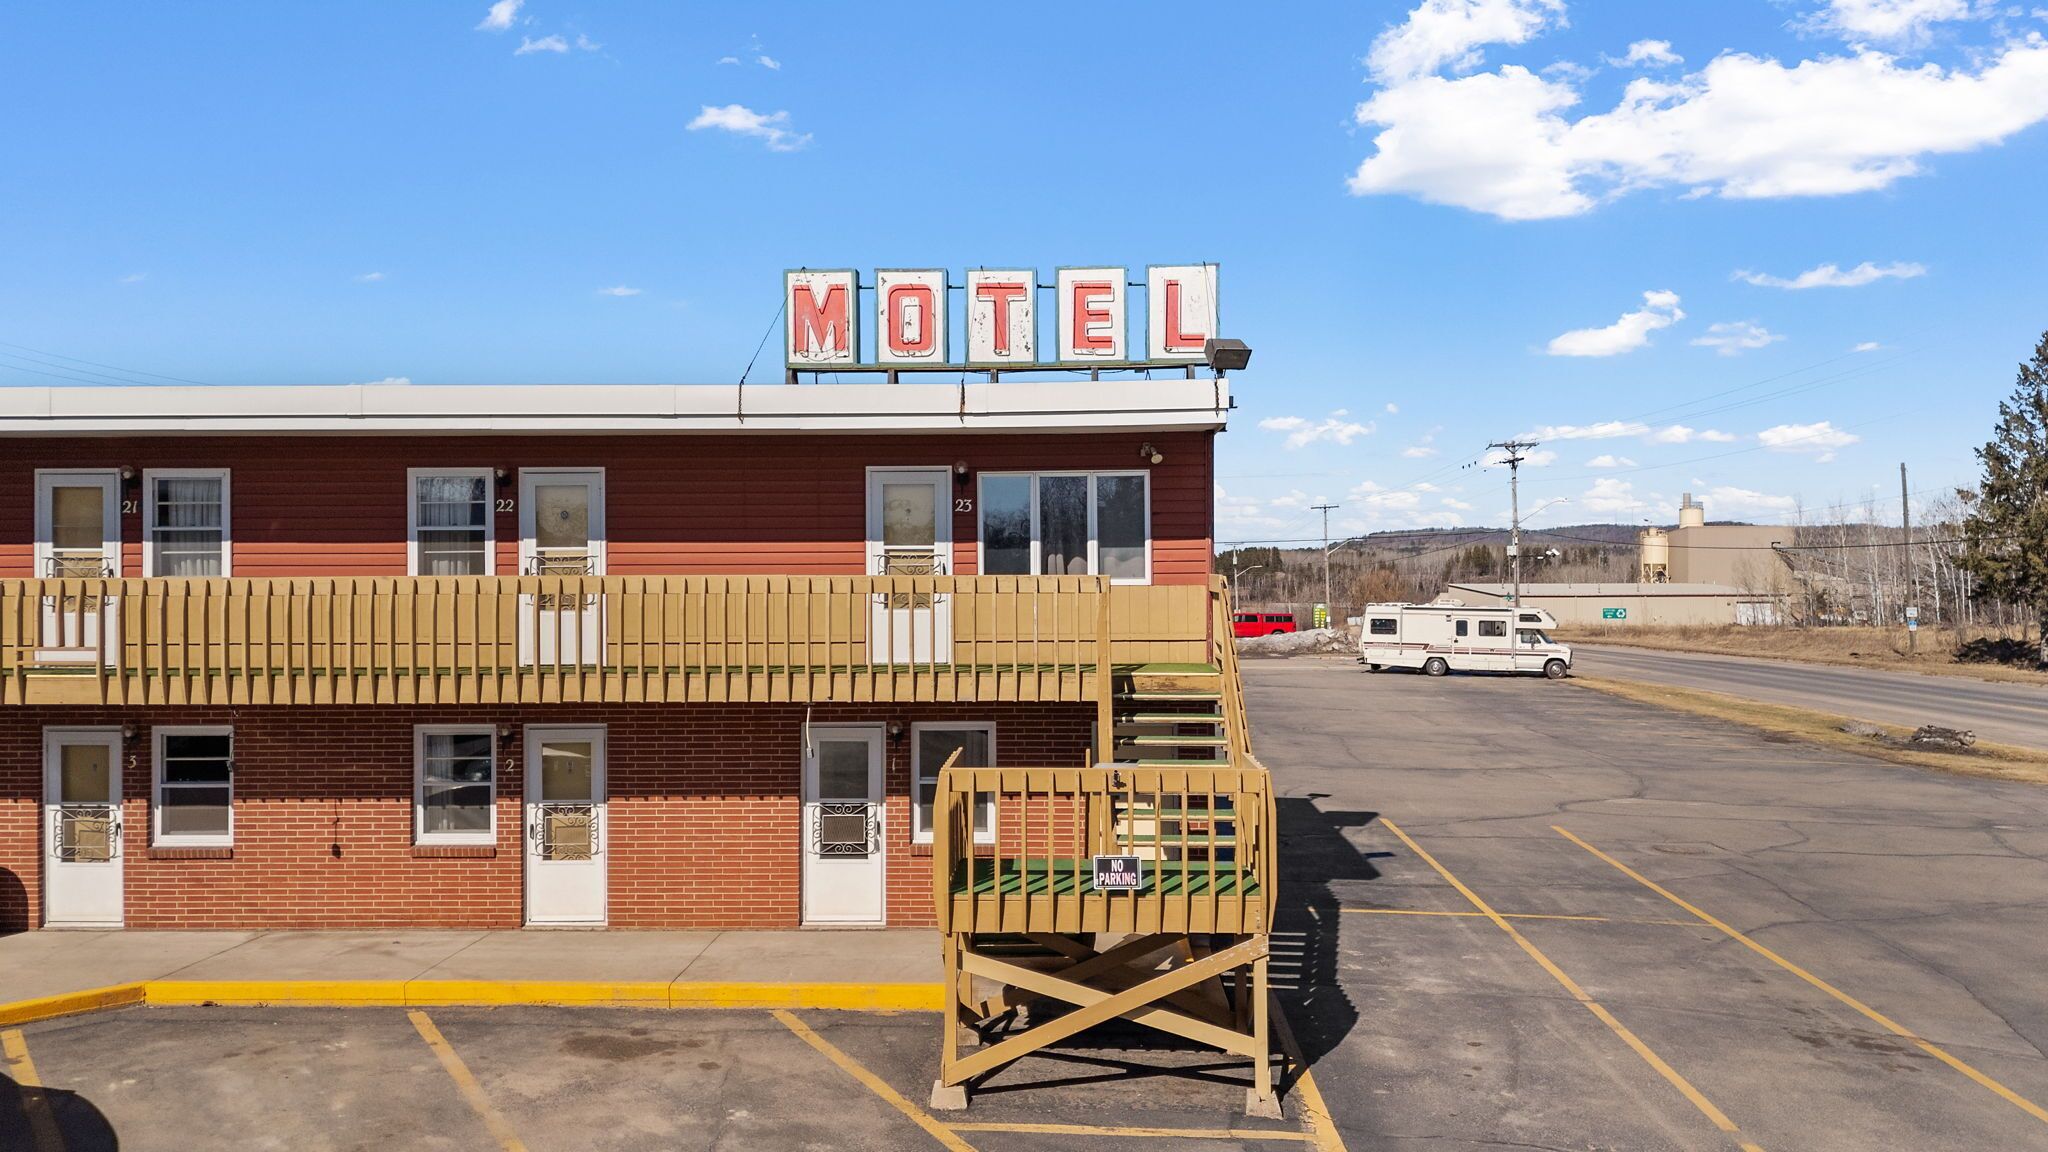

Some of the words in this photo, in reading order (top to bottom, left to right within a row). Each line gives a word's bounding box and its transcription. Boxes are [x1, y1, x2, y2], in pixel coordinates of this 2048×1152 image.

[793, 279, 1207, 357] MOTEL
[122, 500, 138, 514] 21
[496, 499, 514, 512] 22
[955, 498, 972, 512] 23
[127, 755, 137, 769] 3
[505, 758, 515, 772] 2
[1111, 859, 1124, 873] NO
[1098, 872, 1137, 886] PARKING
